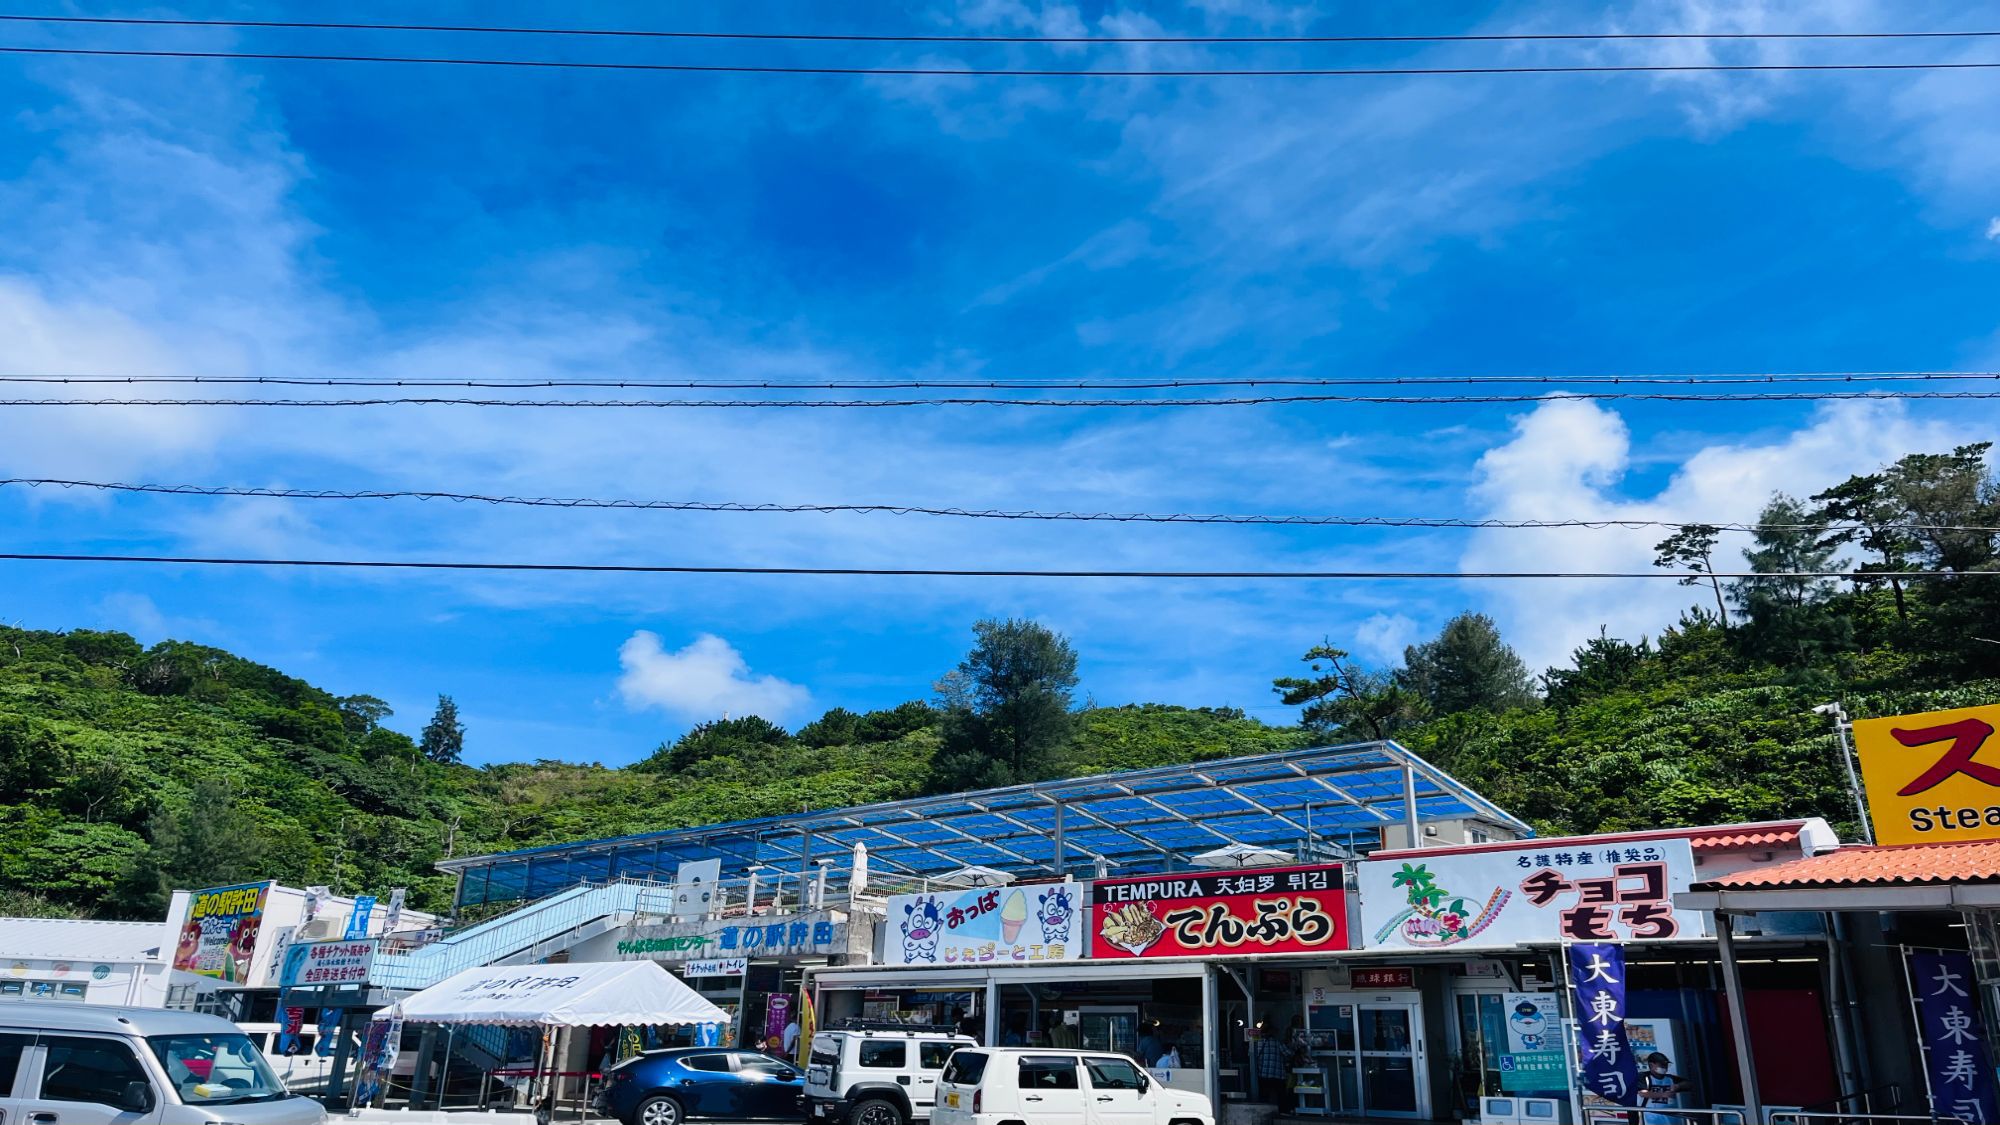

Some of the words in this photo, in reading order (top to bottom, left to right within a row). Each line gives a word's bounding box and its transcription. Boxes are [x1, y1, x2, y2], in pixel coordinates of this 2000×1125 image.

[193, 888, 259, 918] 道の駅許田
[1103, 880, 1203, 902] TEMPURA
[1214, 875, 1275, 895] 天妇罗
[1287, 871, 1328, 890] 튀김
[1521, 864, 1666, 906] チョコ
[946, 889, 1000, 930] おっぱ
[1165, 899, 1331, 946] てんぷら
[1561, 902, 1678, 939] もち
[719, 921, 834, 950] 道の駅許田
[305, 966, 366, 982] 全国発送受付中
[726, 960, 745, 969] トイレ
[1583, 954, 1627, 1099] 大東寿司
[1931, 964, 1986, 1125] 大東寿司
